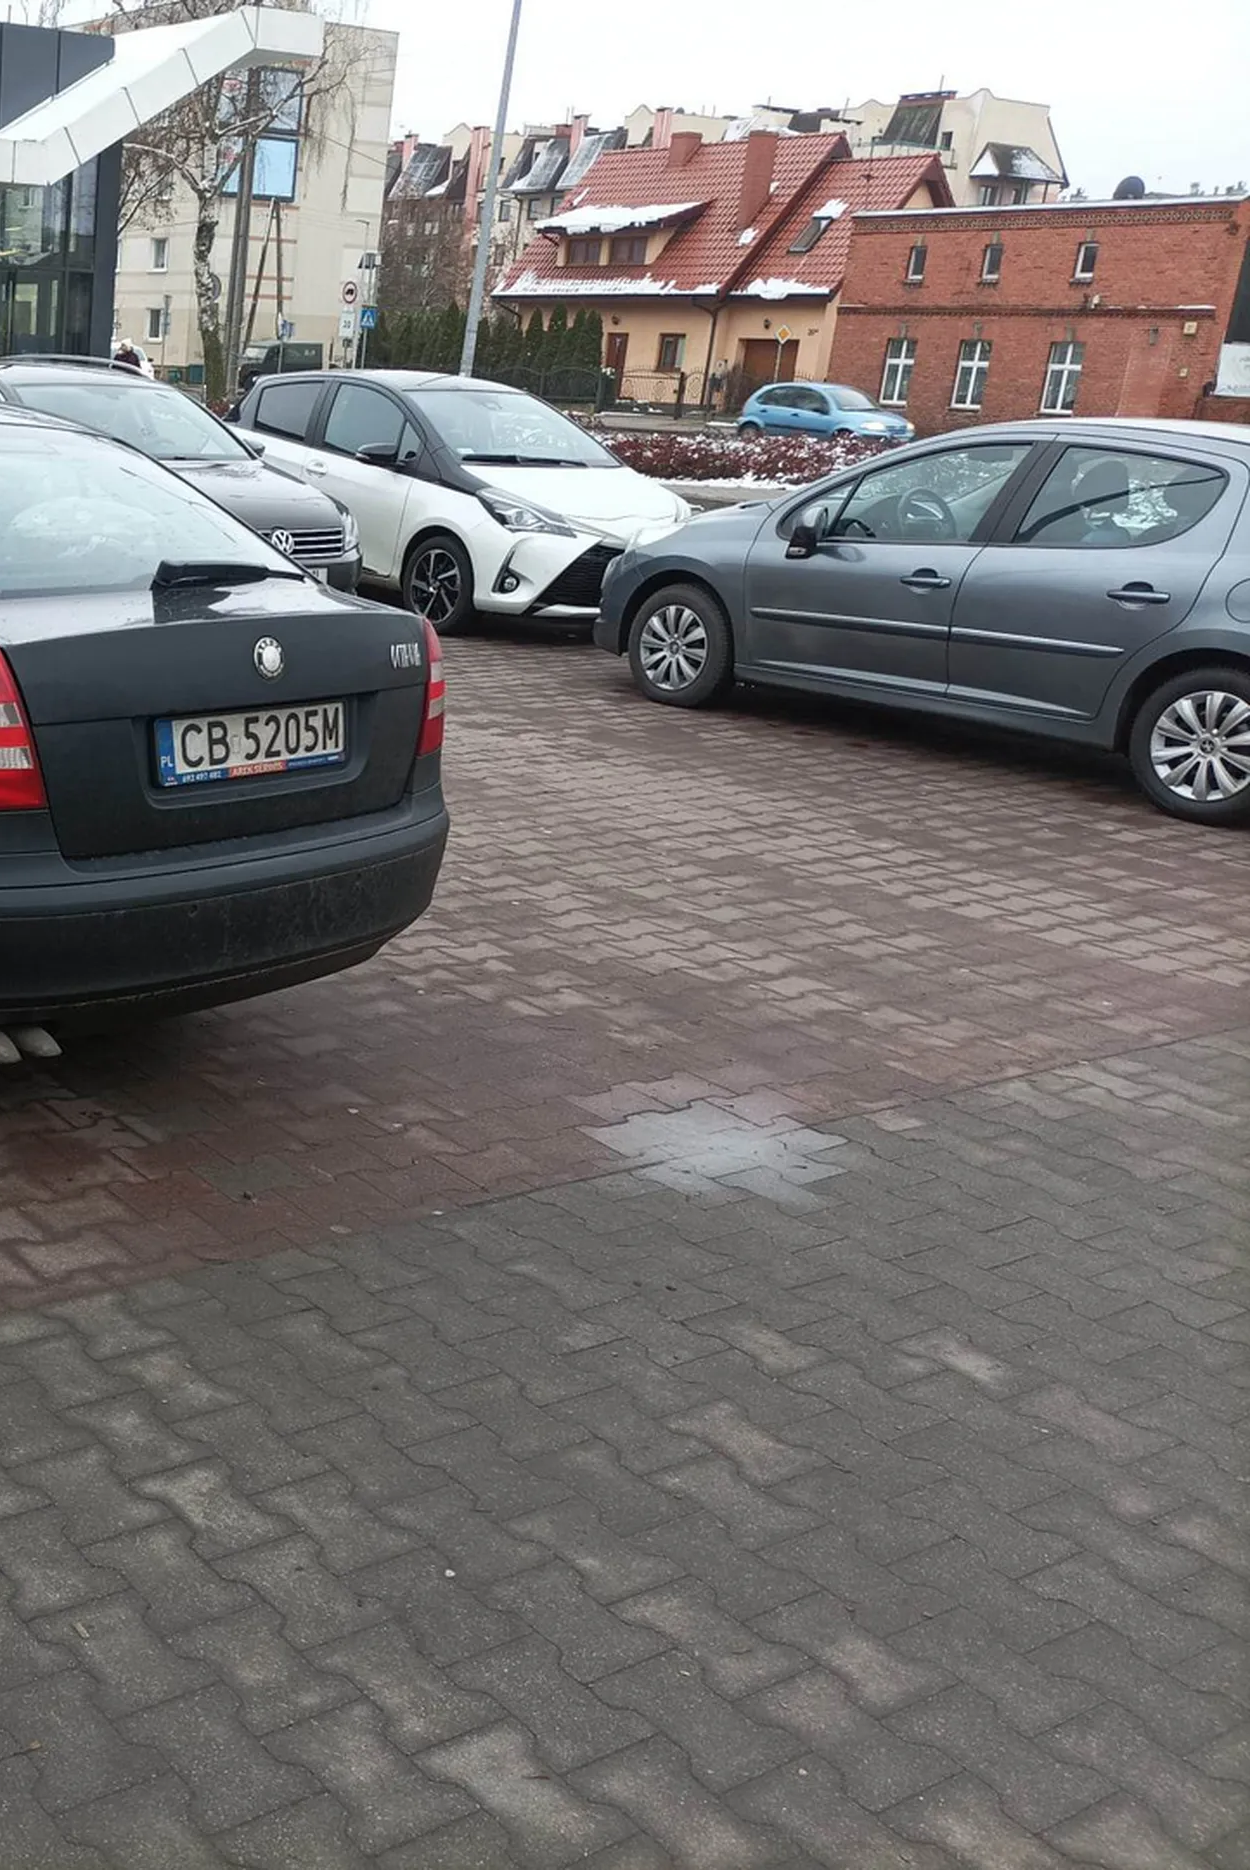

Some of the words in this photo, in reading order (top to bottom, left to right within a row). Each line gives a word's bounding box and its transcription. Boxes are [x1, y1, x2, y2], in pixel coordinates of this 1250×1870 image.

[181, 720, 231, 768] CB
[244, 706, 340, 760] 5205M
[161, 755, 174, 769] PL
